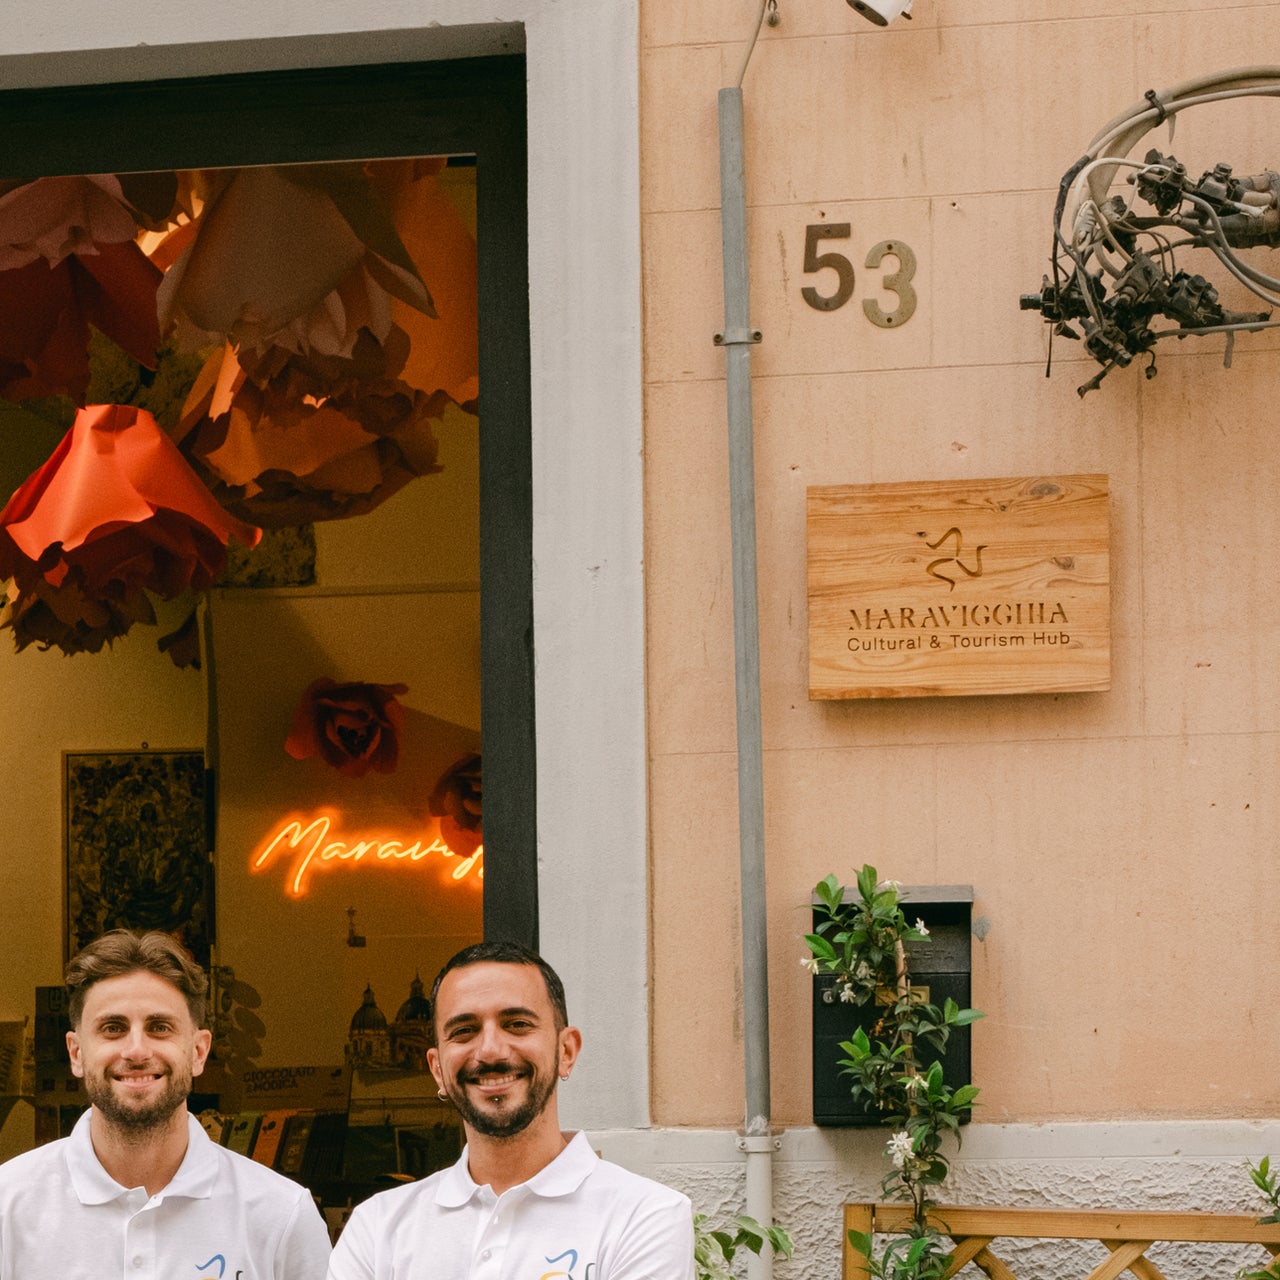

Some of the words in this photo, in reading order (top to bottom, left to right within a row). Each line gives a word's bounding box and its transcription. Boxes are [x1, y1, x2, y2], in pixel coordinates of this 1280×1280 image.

[801, 223, 918, 329] 53
[848, 602, 1069, 631] MARAVIGGHIA
[847, 635, 921, 652] Cultural
[929, 635, 942, 649] &
[949, 633, 1025, 649] Tourism
[1033, 631, 1071, 645] Hub
